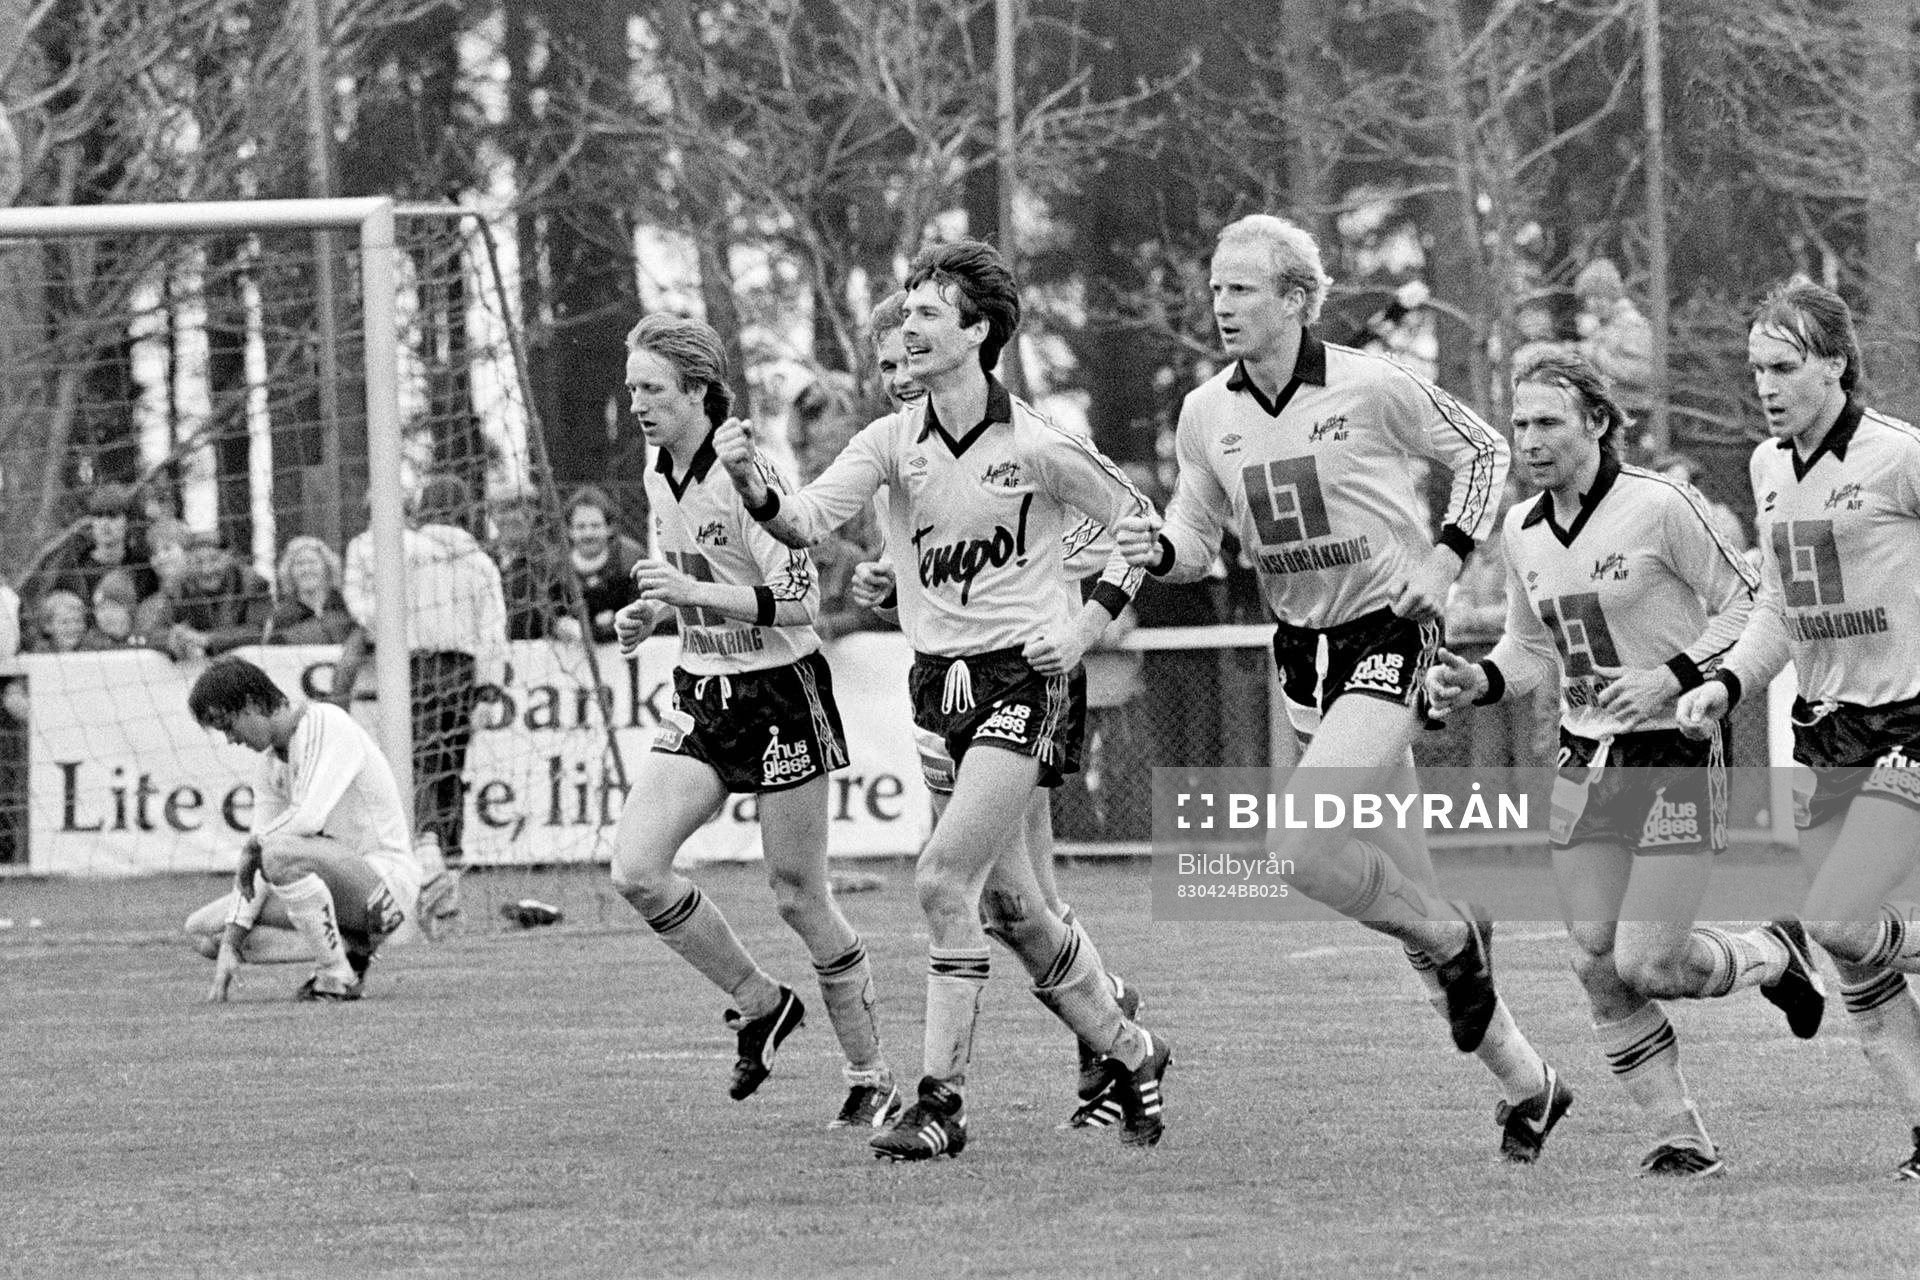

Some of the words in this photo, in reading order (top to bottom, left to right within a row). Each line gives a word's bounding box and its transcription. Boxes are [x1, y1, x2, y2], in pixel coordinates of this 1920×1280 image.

[1333, 430, 1350, 441] AIF
[1003, 478, 1020, 488] AIF
[1846, 500, 1864, 511] AIF
[713, 536, 728, 546] AIF
[910, 492, 1034, 607] Tempo!
[1613, 569, 1630, 581] AIF
[763, 754, 811, 779] glass
[55, 760, 204, 832] Lite
